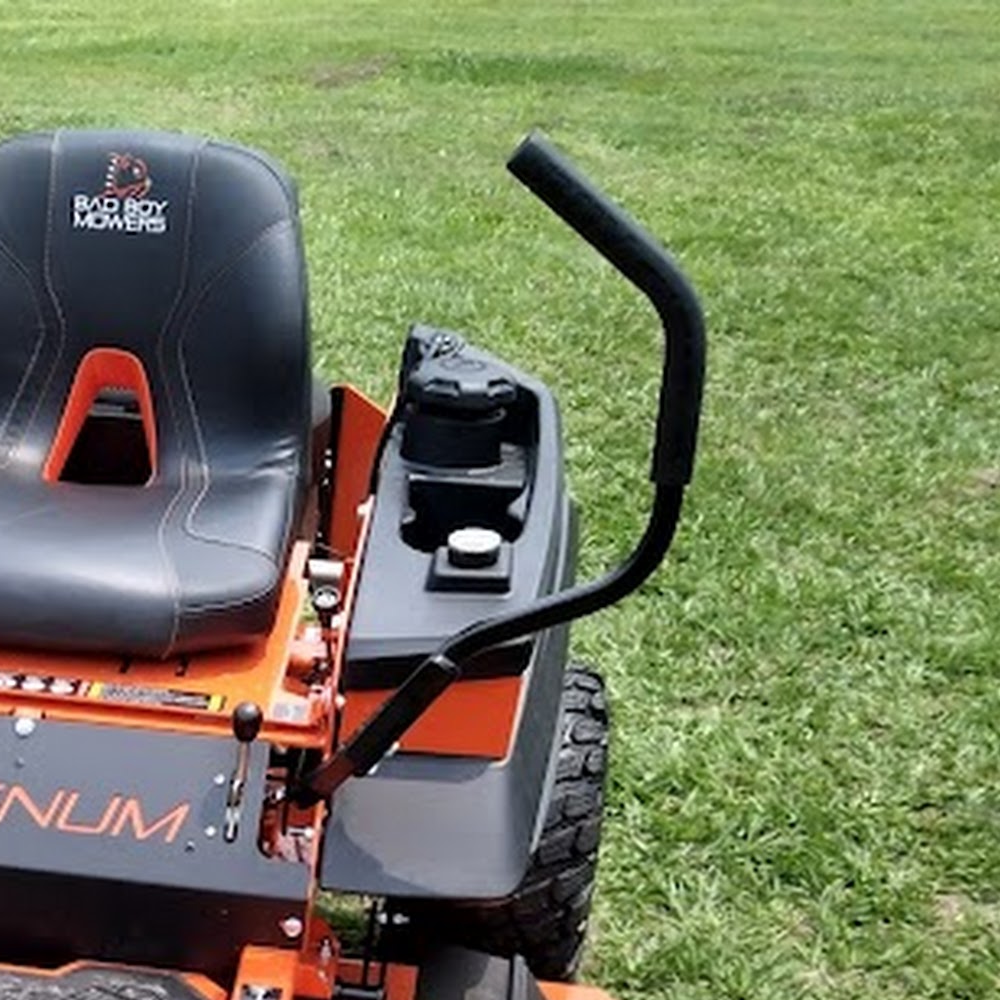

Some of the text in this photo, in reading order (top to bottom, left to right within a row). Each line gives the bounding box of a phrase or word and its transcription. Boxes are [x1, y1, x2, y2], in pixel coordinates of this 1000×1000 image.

[73, 194, 168, 217] BAD BOY
[73, 211, 166, 233] MOWERS
